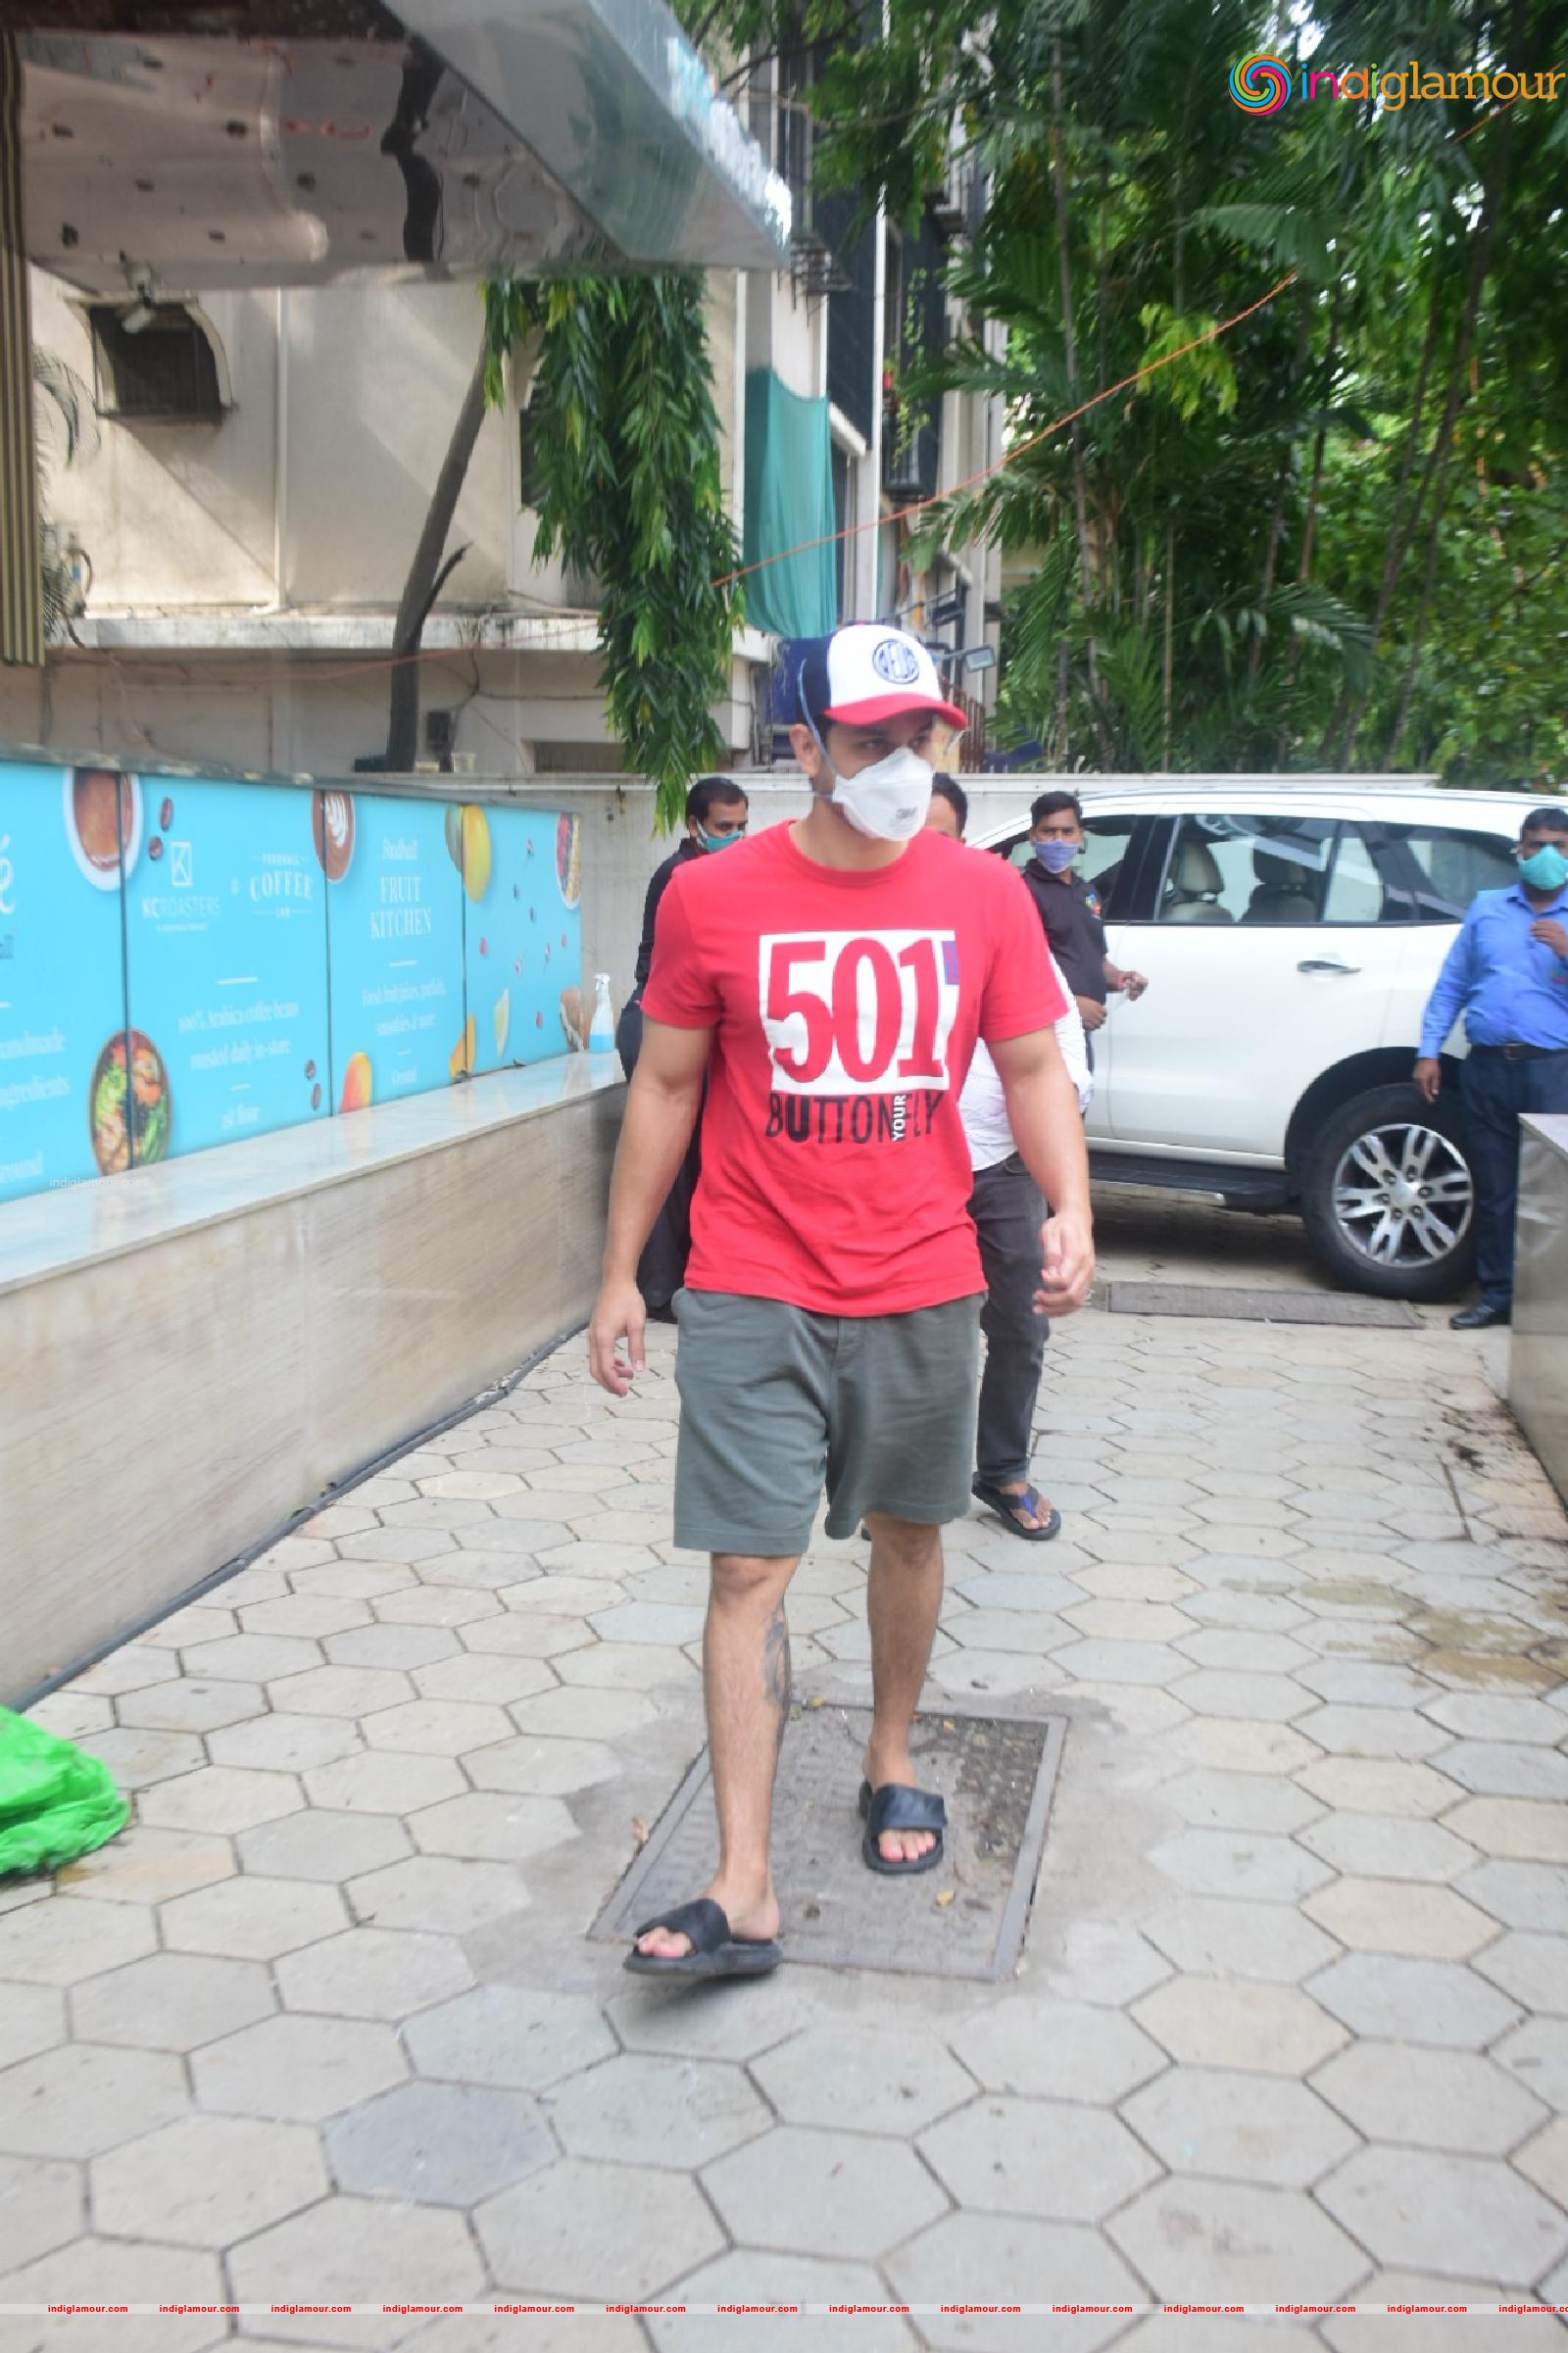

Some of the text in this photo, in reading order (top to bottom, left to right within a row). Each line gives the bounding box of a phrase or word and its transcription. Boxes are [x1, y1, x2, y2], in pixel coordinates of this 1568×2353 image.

[250, 870, 312, 901] COFFEE
[380, 876, 421, 903] FRUIT
[369, 907, 432, 939] KITCHEN
[245, 999, 271, 1023] coffee
[768, 937, 944, 1083] 501
[229, 1038, 252, 1065] daily
[765, 1091, 895, 1145] BUTTON
[891, 1093, 907, 1143] YOUR
